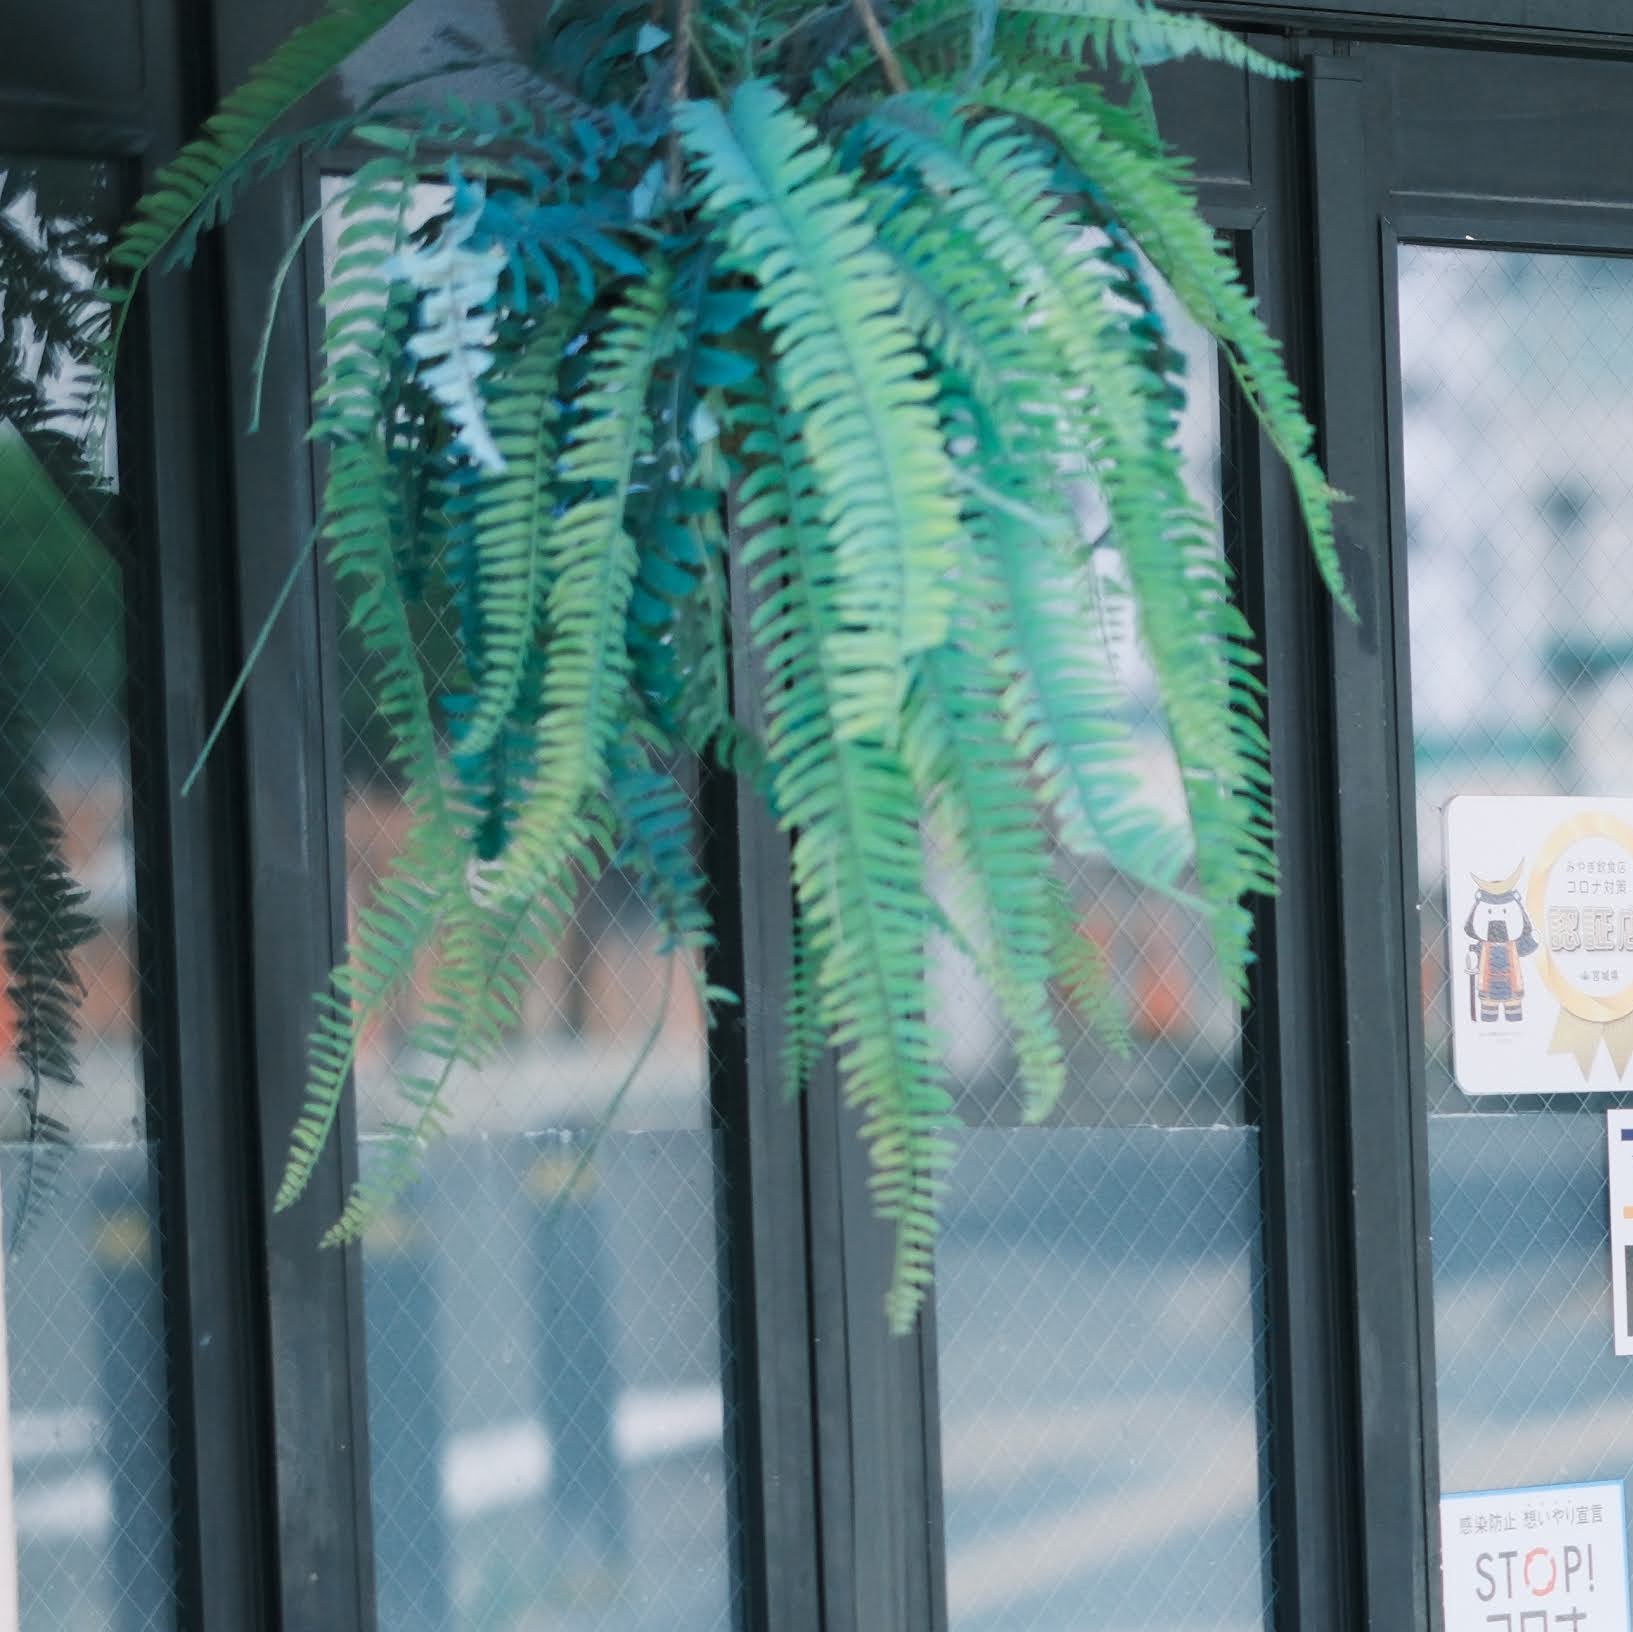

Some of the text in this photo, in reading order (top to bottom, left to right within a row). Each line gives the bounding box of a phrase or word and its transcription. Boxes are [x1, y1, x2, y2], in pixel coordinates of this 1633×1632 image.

[1567, 879, 1627, 895] コロナ対策
[1459, 1504, 1604, 1535] 感染防止 想いやり宣言
[1475, 1543, 1596, 1602] STOP!
